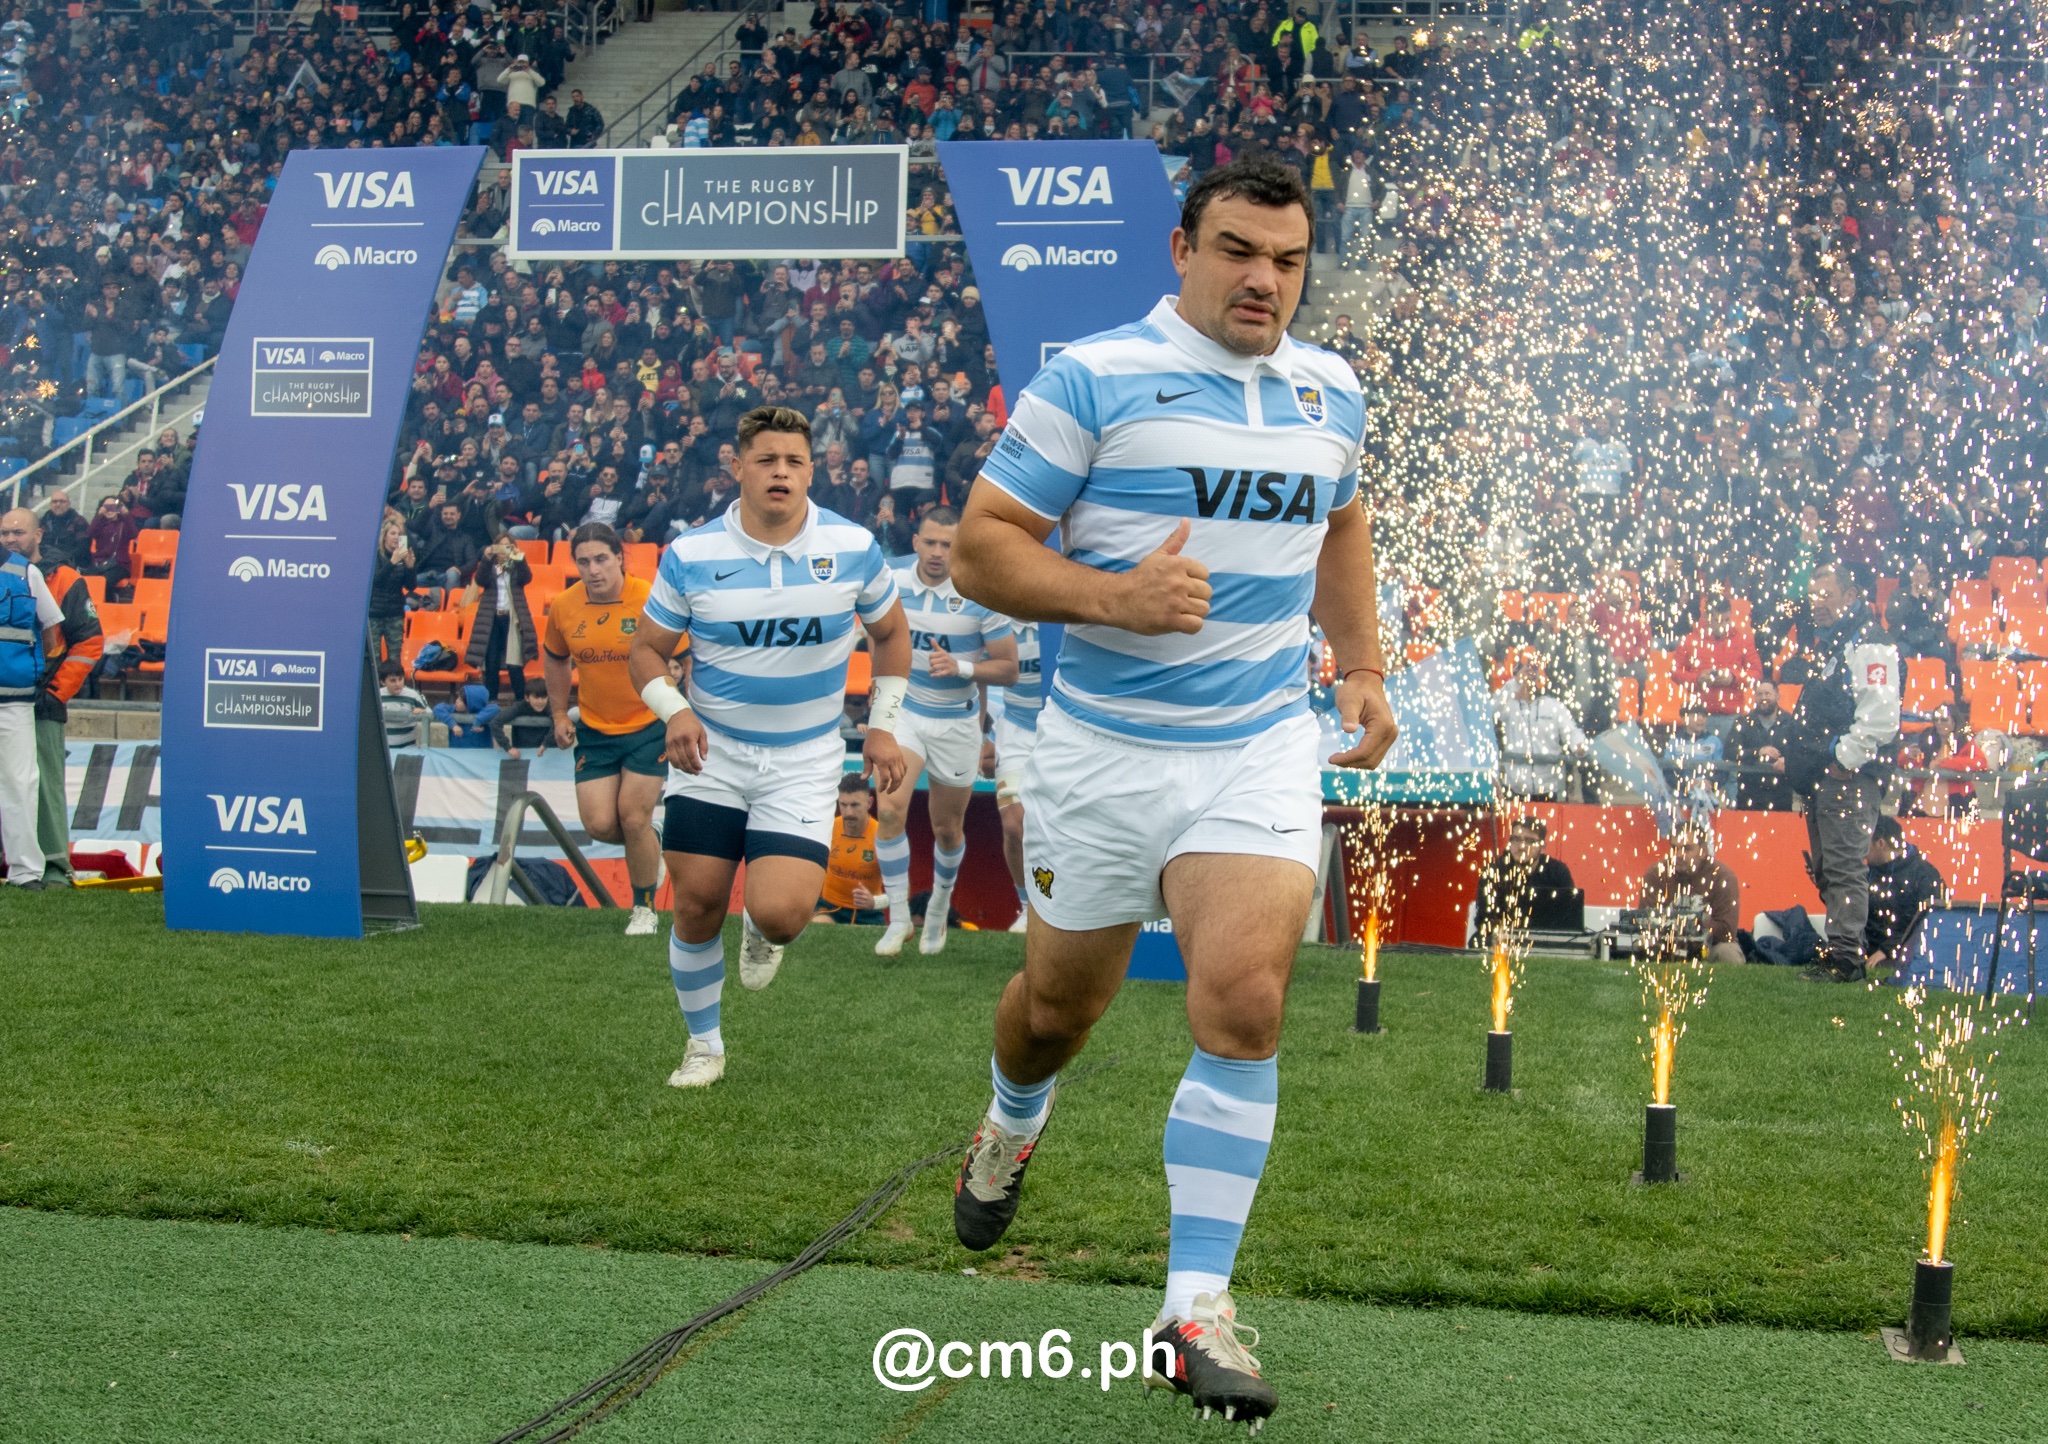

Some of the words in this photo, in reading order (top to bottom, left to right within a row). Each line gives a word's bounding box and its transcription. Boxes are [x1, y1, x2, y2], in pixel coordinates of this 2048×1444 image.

[314, 171, 415, 208] VISA
[530, 170, 599, 195] VISA
[704, 180, 741, 194] THE
[751, 179, 815, 193] RUGBY
[998, 166, 1113, 205] VISA
[641, 165, 879, 227] CHAMPIONSHIP
[557, 219, 601, 233] Macro
[353, 246, 418, 266] Macro
[1046, 246, 1118, 265] Macro
[262, 347, 306, 365] VISA
[336, 351, 365, 361] Macro
[263, 381, 361, 403] CHAMPIONSHIP
[289, 382, 305, 390] THE
[1302, 403, 1324, 416] UAR
[226, 483, 327, 521] VISA
[1176, 467, 1316, 524] VISA
[267, 559, 330, 578] Macro
[729, 618, 823, 647] VISA
[214, 658, 258, 677] VISA
[288, 664, 316, 675] Macro
[215, 693, 311, 716] CHAMPIONSHIP
[241, 694, 257, 702] THE
[260, 695, 287, 703] RUGBY
[206, 794, 307, 834] VISA
[248, 871, 311, 892] Macro
